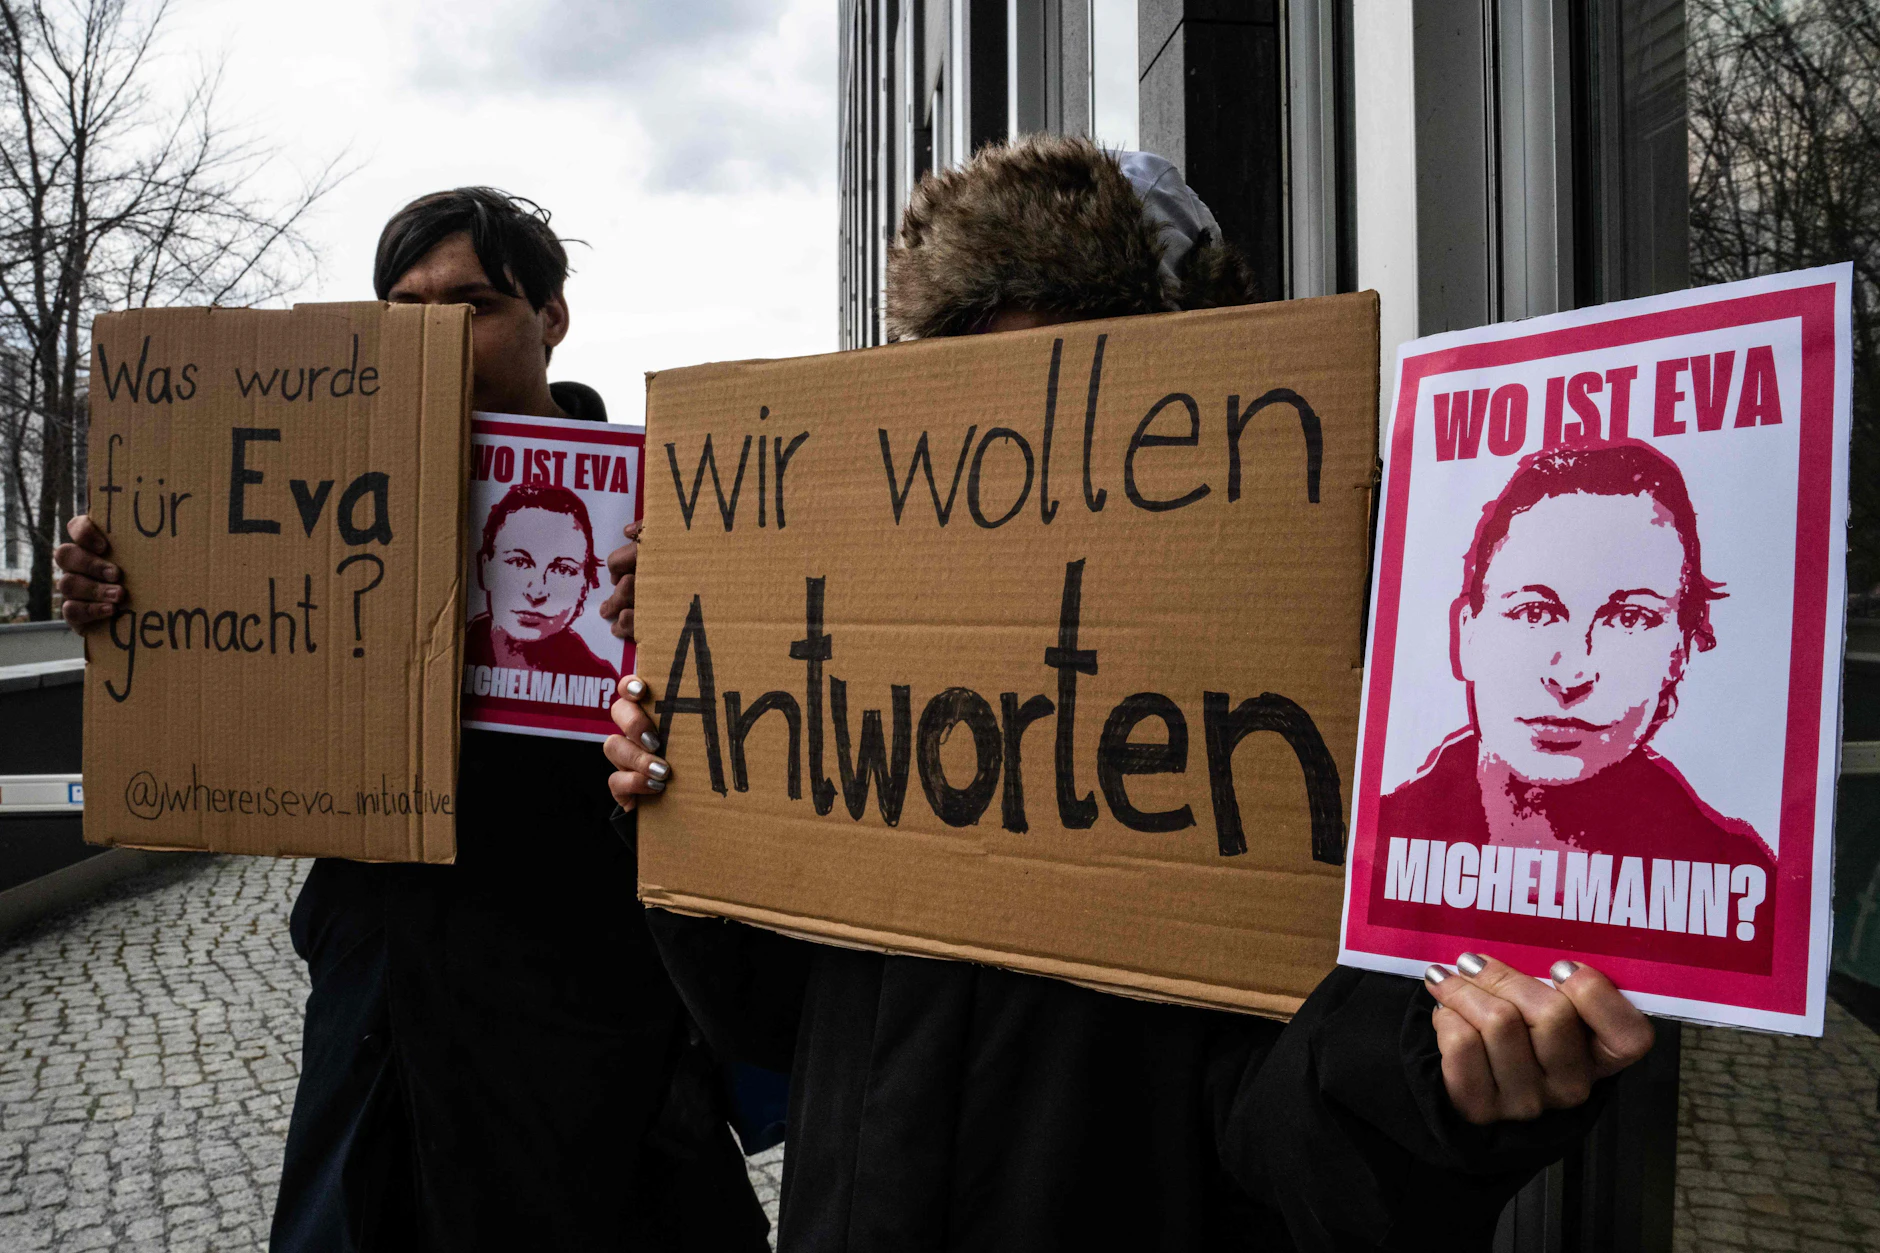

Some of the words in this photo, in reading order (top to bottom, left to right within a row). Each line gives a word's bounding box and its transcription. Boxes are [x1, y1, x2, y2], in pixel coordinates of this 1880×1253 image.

[97, 335, 198, 404] Was
[235, 334, 380, 402] wurde
[1433, 384, 1528, 462] WO
[1543, 364, 1640, 446] IST
[1652, 344, 1783, 438] EVA
[99, 433, 193, 538] für
[228, 426, 394, 546] Eva
[471, 445, 515, 484] WO
[521, 448, 568, 488] IST
[574, 453, 629, 494] EVA
[664, 406, 810, 532] wir
[878, 334, 1324, 530] wollen
[464, 664, 616, 710] ICHELMANN?
[655, 558, 1346, 866] Antworten
[1384, 836, 1767, 941] MICHELMANN?
